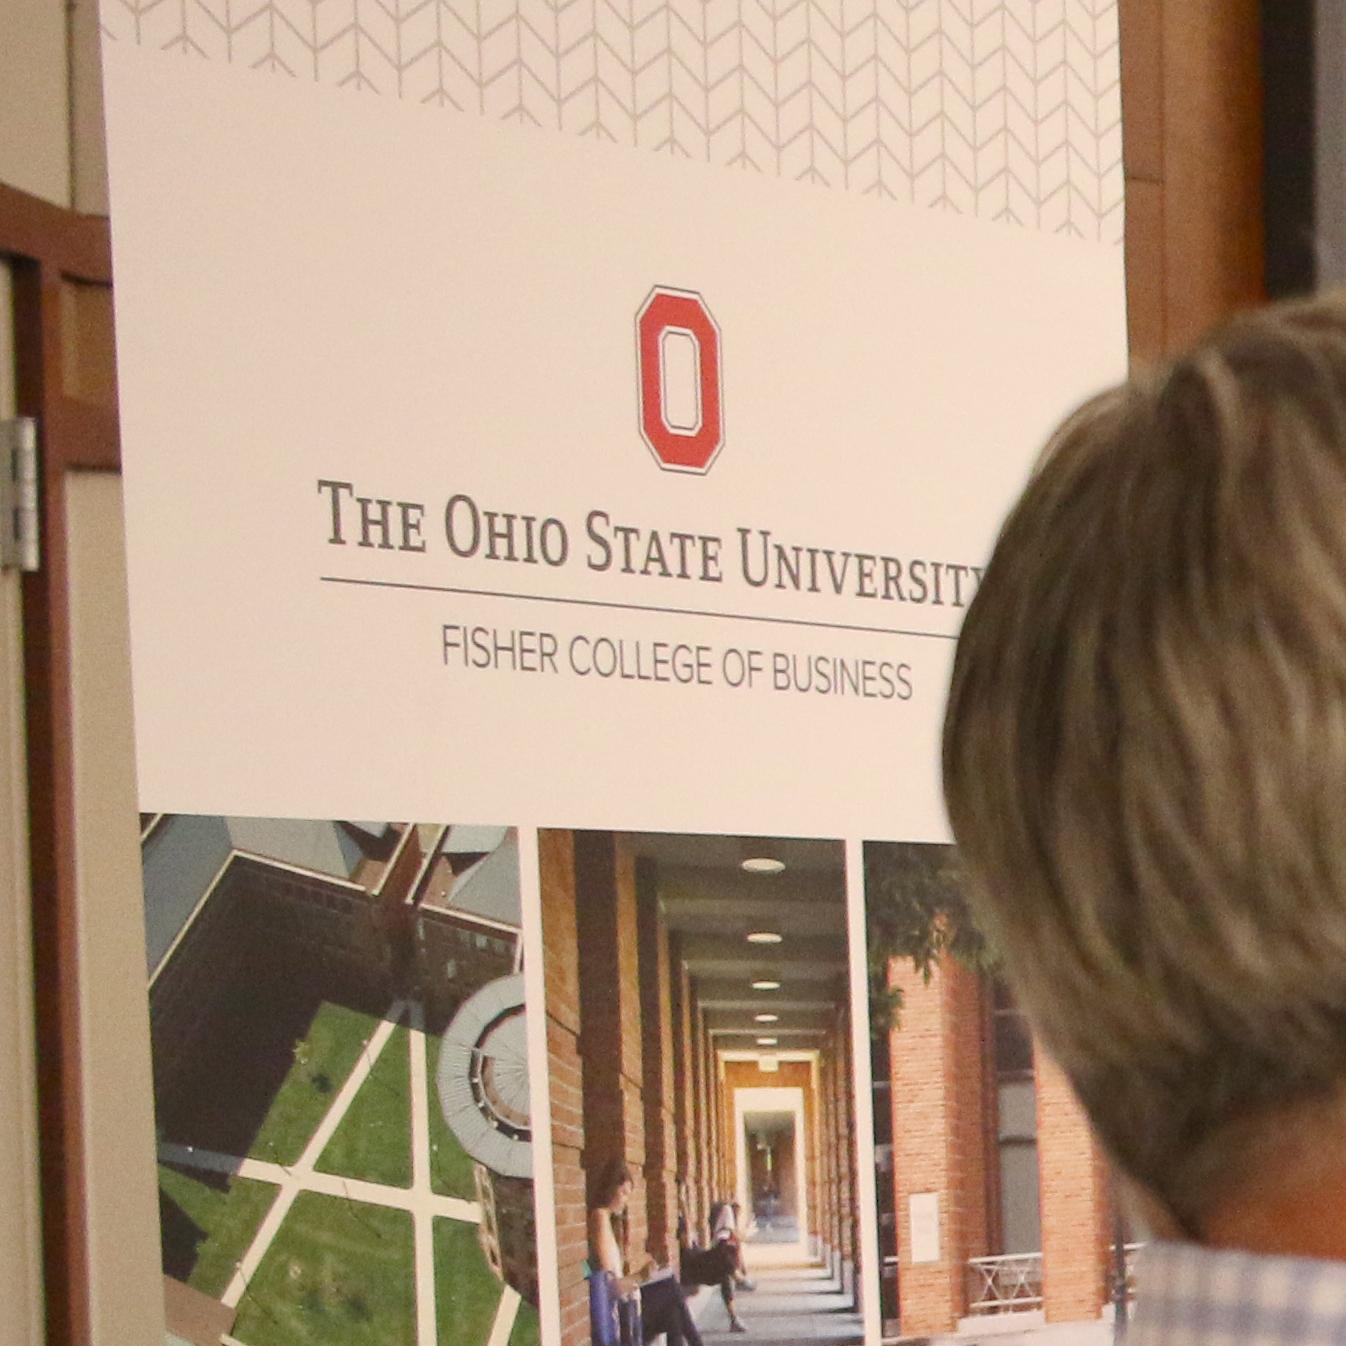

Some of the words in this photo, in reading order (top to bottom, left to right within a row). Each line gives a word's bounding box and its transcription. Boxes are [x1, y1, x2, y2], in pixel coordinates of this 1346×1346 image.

[634, 284, 726, 475] O
[317, 479, 426, 553] THE
[444, 494, 570, 567] OHIO
[585, 509, 722, 582] STATE
[441, 623, 559, 675] FISHER
[568, 633, 713, 685] COLLEGE
[722, 649, 763, 690] OF
[773, 654, 914, 701] BUSINESS
